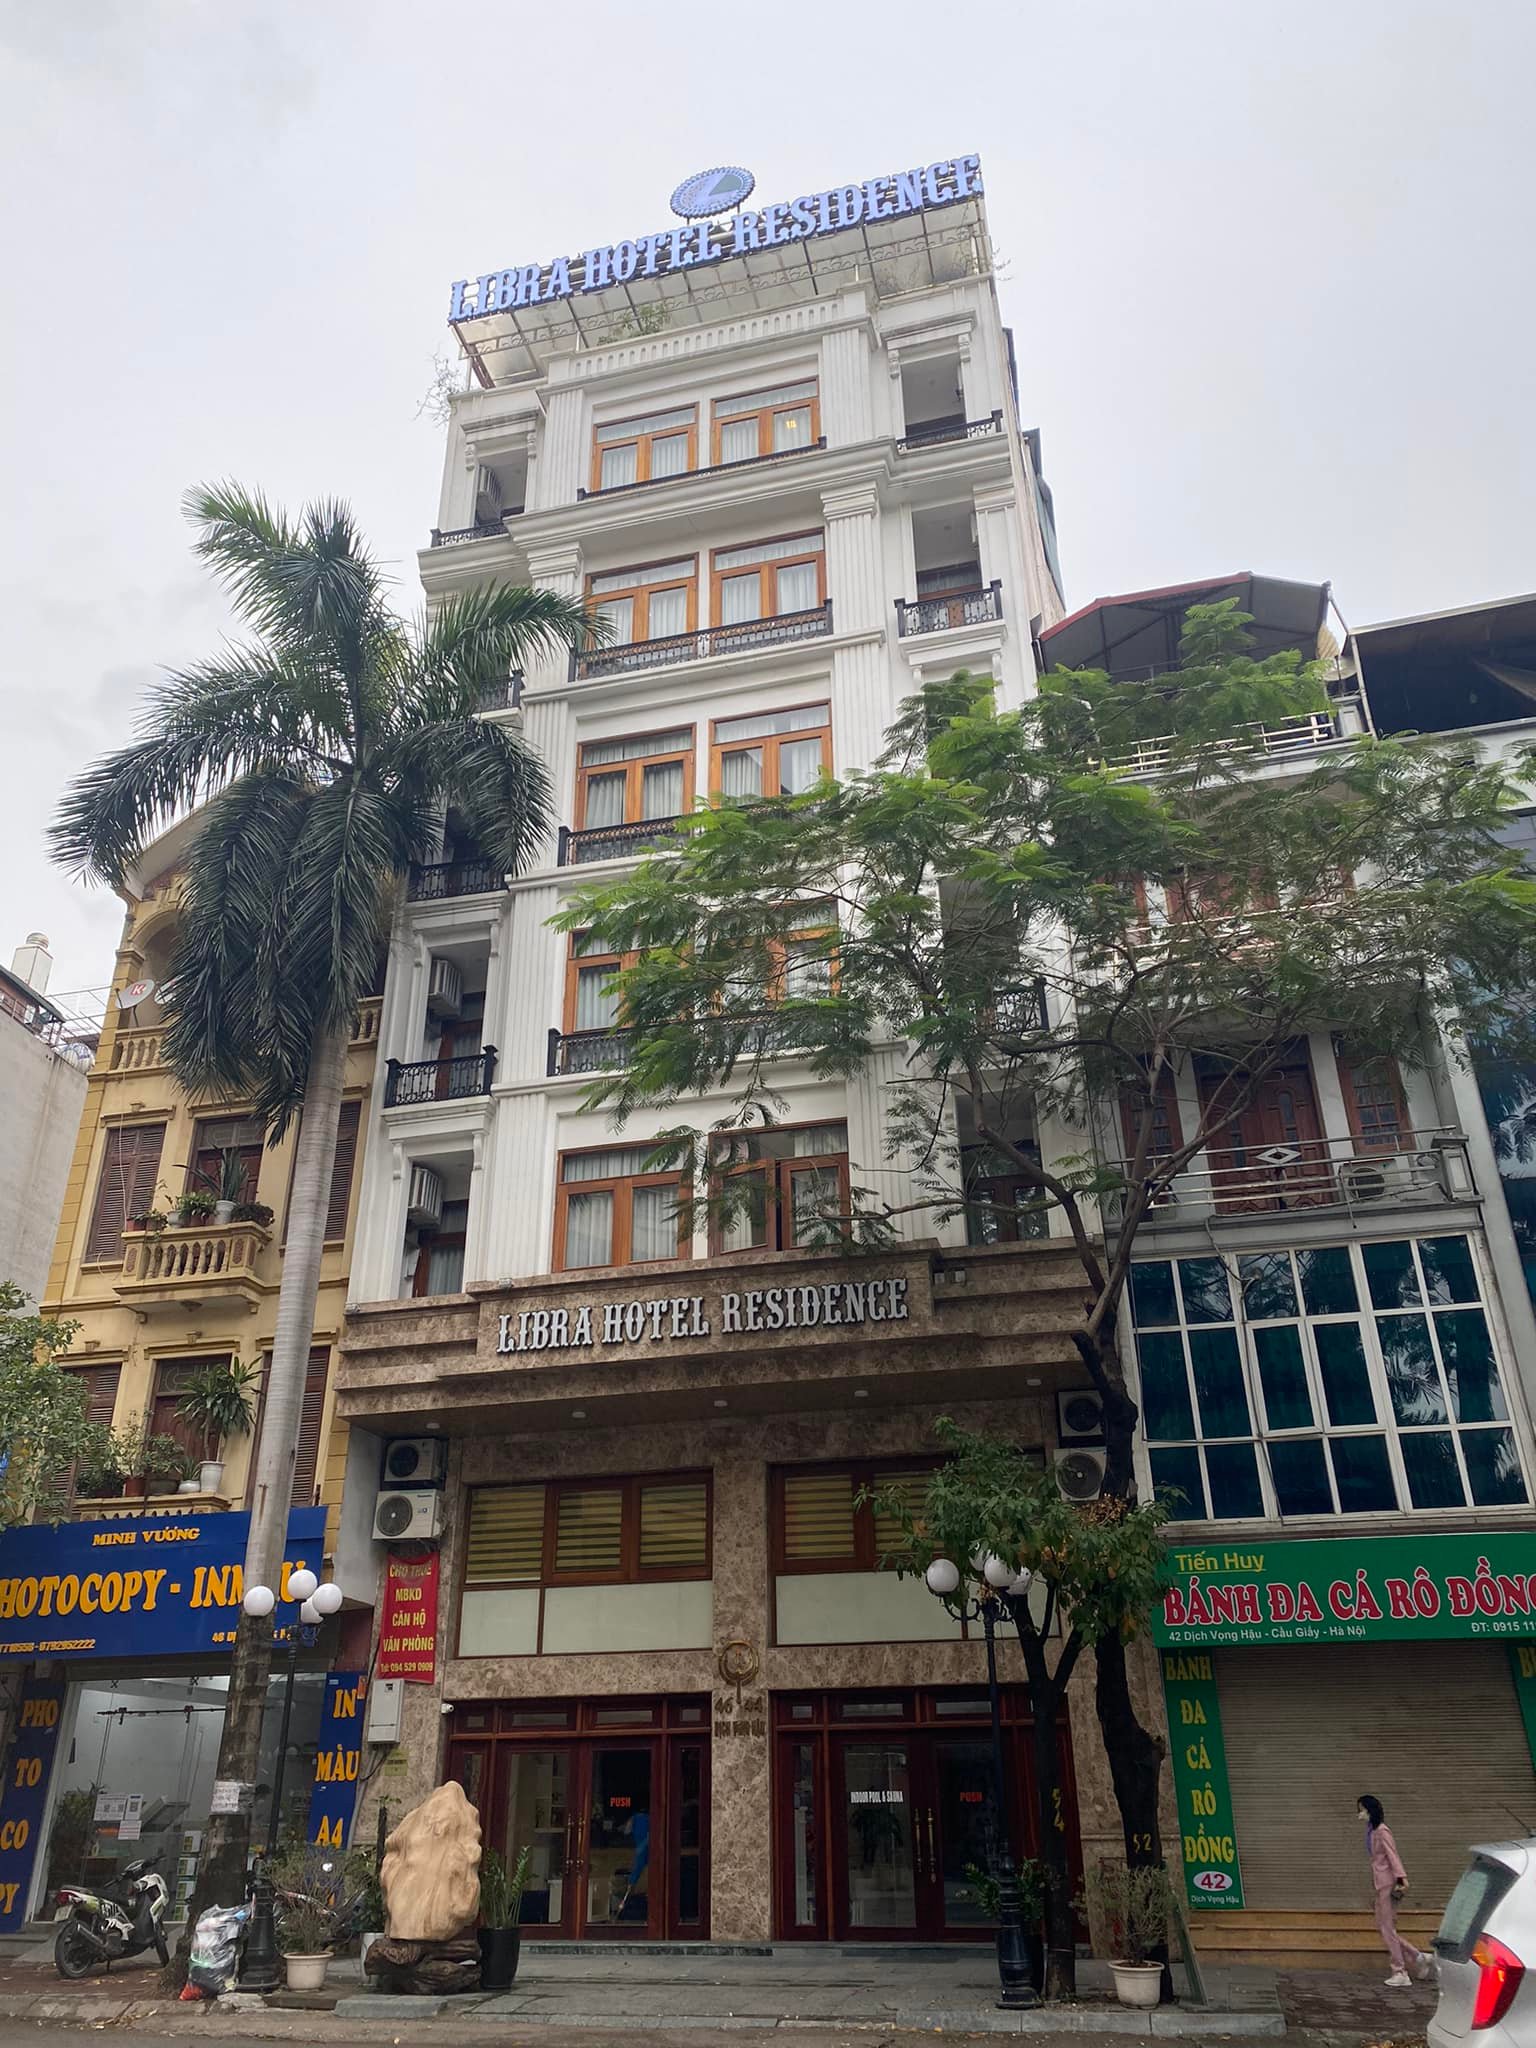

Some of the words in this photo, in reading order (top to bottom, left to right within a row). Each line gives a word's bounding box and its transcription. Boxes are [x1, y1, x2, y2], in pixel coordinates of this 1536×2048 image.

[448, 255, 571, 323] LIBRA
[580, 222, 722, 291] HOTEL
[730, 153, 983, 254] RESIDENCE
[497, 1305, 593, 1353] LIBRA
[601, 1295, 710, 1343] HOTEL
[720, 1277, 910, 1333] RESIDENCE
[92, 1531, 137, 1546] MINH
[1175, 1551, 1219, 1572] Tiến
[1223, 1552, 1264, 1573] Huy
[395, 1587, 422, 1602] MBKD
[1266, 1581, 1324, 1621] ĐA
[1328, 1568, 1383, 1620] CÁ
[1384, 1566, 1441, 1618] RÔ
[412, 1608, 426, 1628] HỘ
[1471, 1622, 1490, 1632] ĐT:
[1493, 1620, 1520, 1632] 0915
[1169, 1632, 1181, 1641] 42
[1184, 1630, 1208, 1643] Dịch
[1210, 1630, 1238, 1642] Vọng
[1240, 1628, 1262, 1641] Hậu
[1329, 1626, 1345, 1637] Hà
[1347, 1625, 1366, 1638] Nội
[20, 1701, 58, 1728] PHO
[333, 1689, 357, 1718] IN
[715, 1697, 733, 1714] 46
[1181, 1700, 1207, 1724] ĐA
[15, 1758, 42, 1787] TO
[315, 1744, 360, 1782] MÀU
[610, 1797, 631, 1808] PUSH
[1191, 1782, 1217, 1815] RÔ
[1, 1819, 29, 1851] CO
[316, 1815, 343, 1849] A4
[1184, 1823, 1235, 1863] ĐỒNG
[1201, 1873, 1226, 1889] 42
